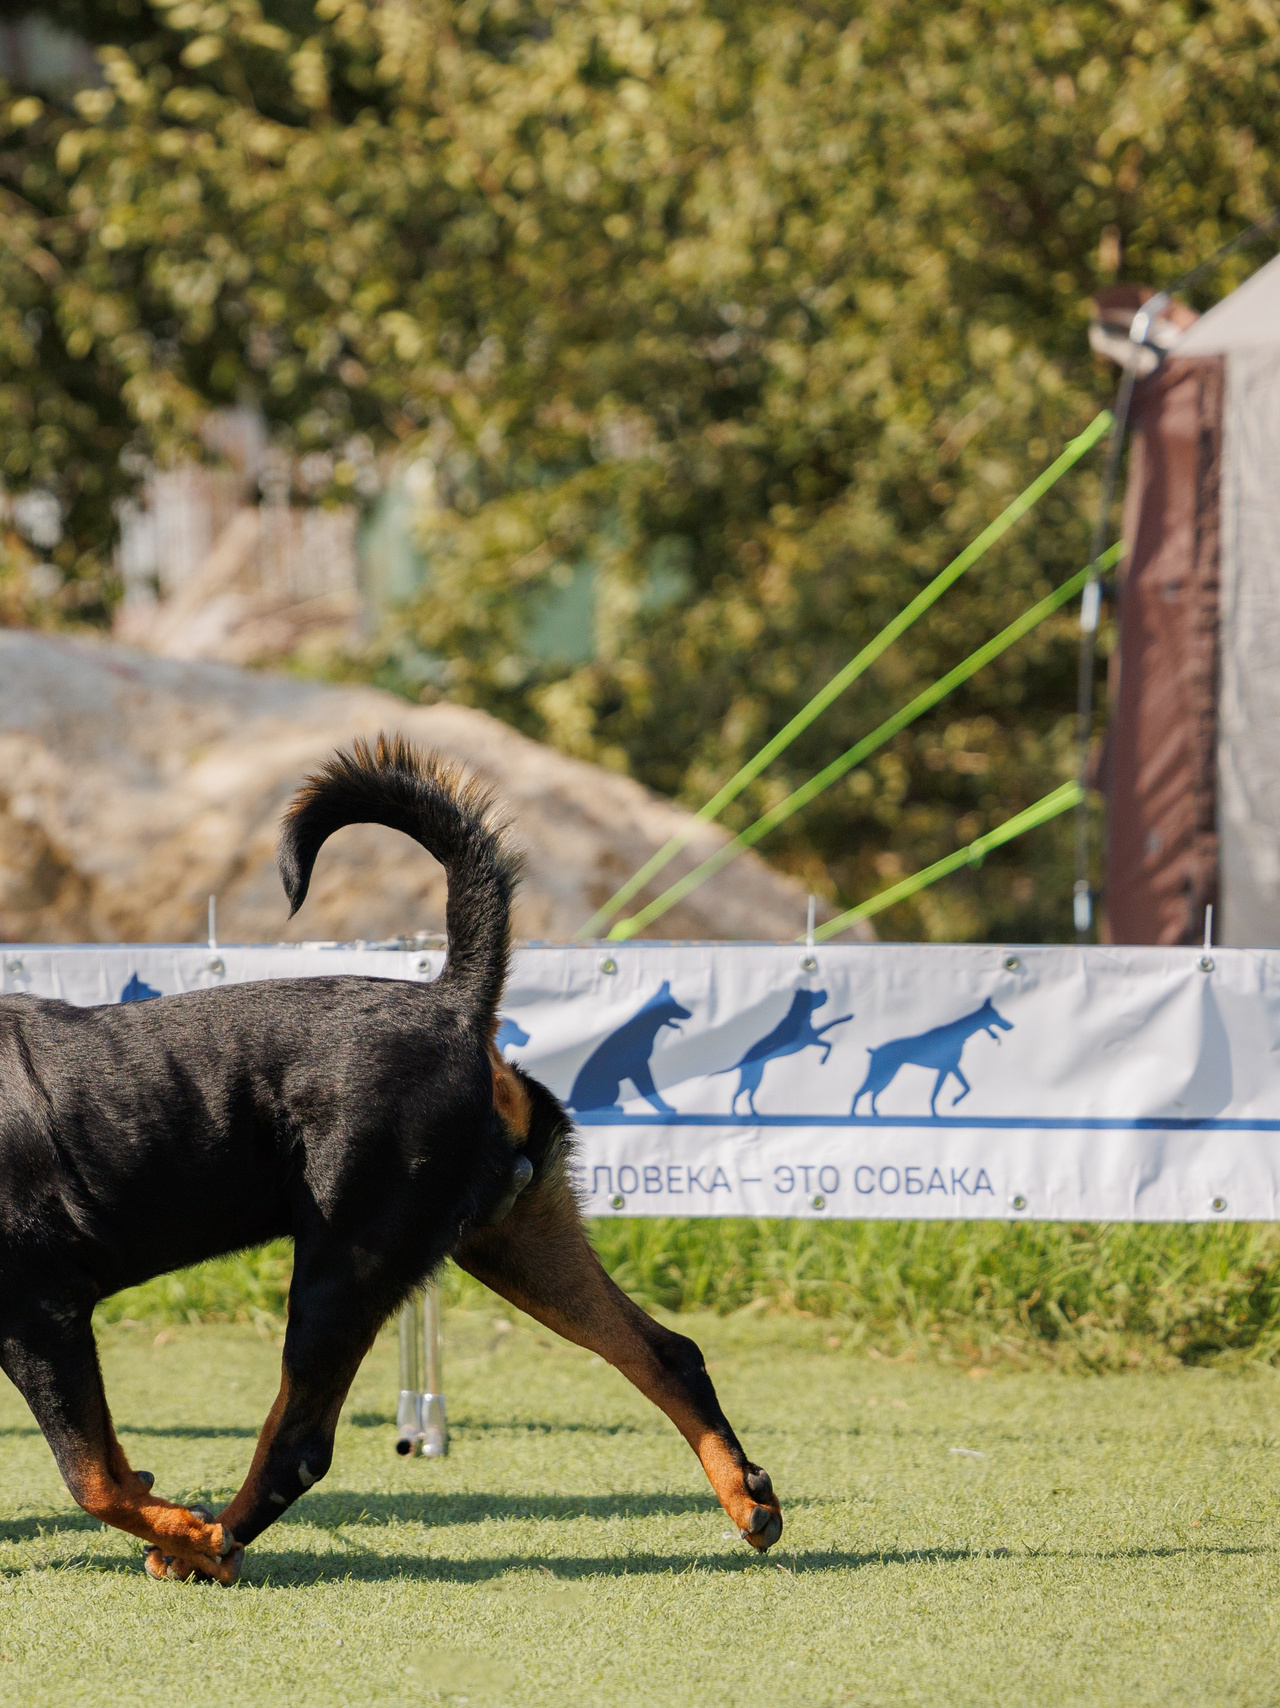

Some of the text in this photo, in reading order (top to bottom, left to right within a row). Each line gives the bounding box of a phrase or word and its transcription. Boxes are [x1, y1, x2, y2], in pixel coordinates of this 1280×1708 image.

[573, 1165, 732, 1194] ЕЛОВЕКА
[773, 1165, 841, 1194] ЭТО
[853, 1165, 996, 1196] СОБАКА
